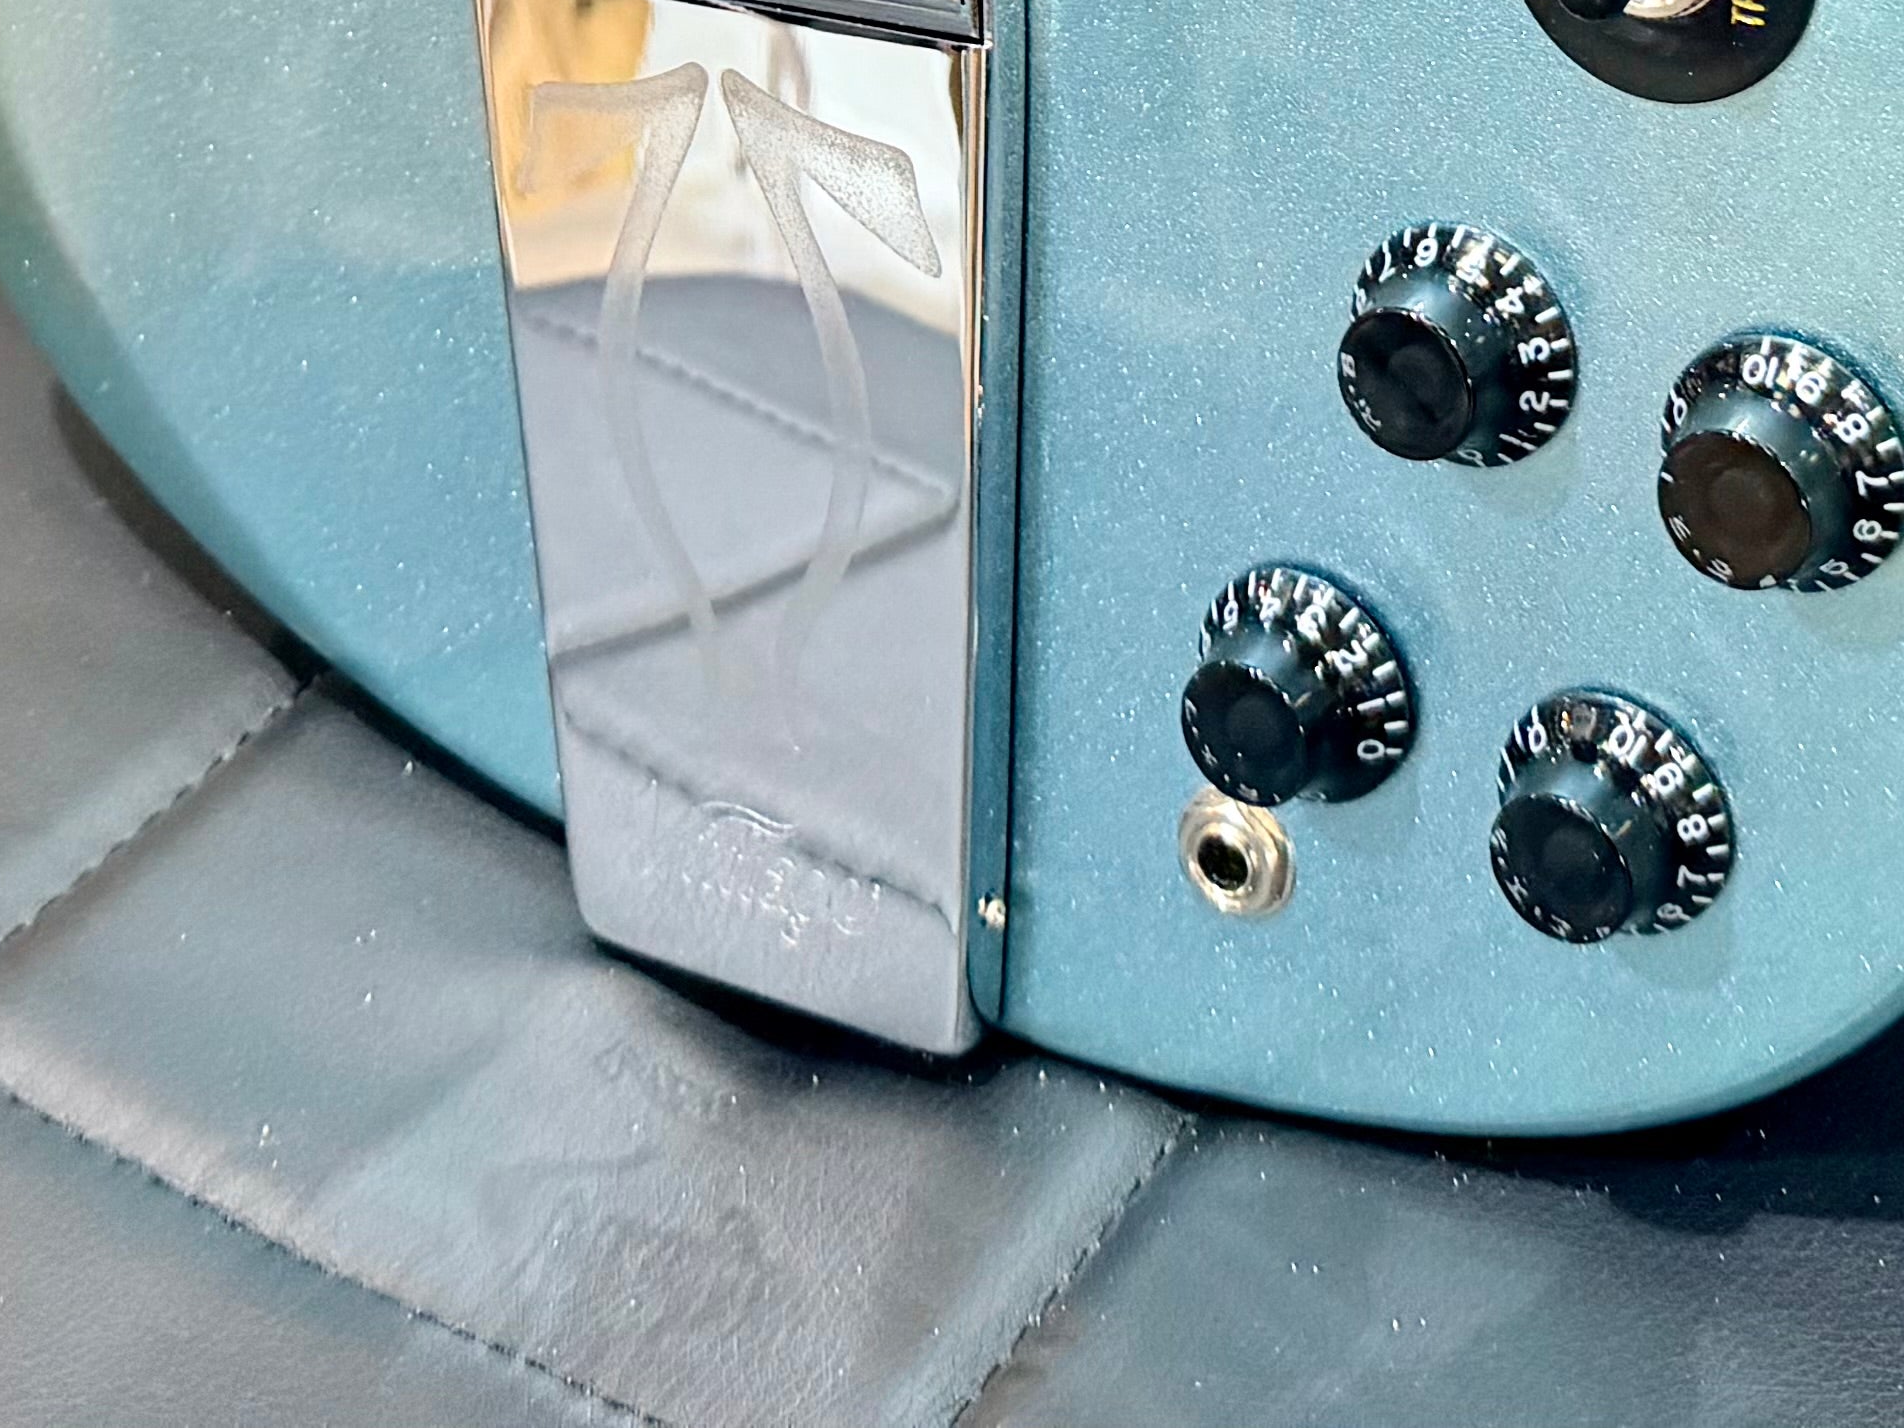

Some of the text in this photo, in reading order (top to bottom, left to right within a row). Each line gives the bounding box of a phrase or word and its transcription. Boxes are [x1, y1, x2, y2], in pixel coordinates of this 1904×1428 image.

[1517, 336, 1552, 367] 3
[1519, 390, 1551, 414] 2
[1835, 412, 1871, 444] 8
[1855, 470, 1890, 497] 7
[1356, 738, 1386, 761] 0
[1676, 813, 1709, 844] 8
[1676, 864, 1708, 889] 7
